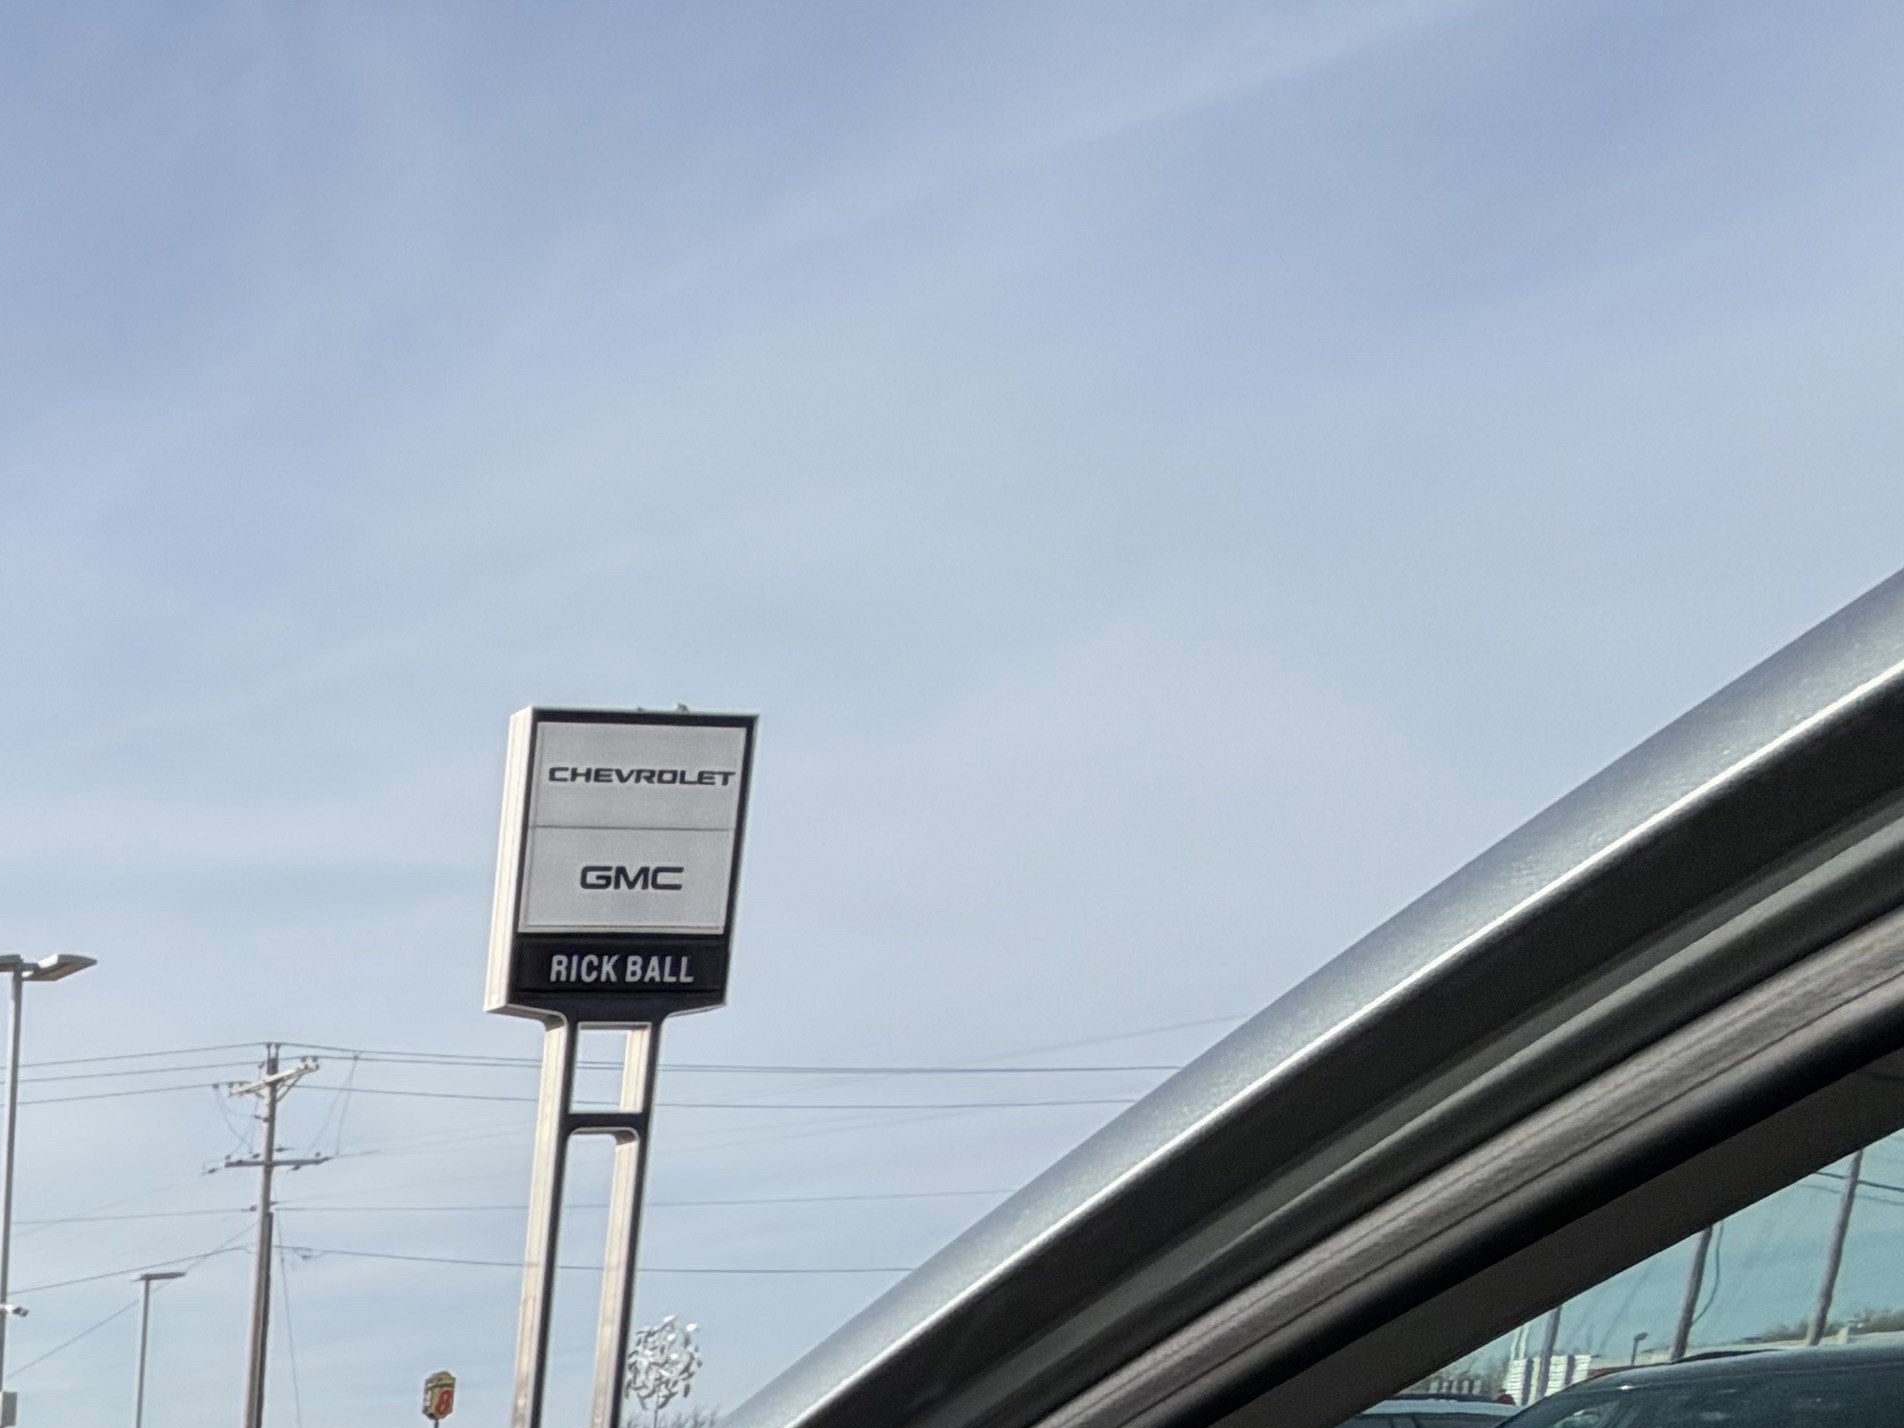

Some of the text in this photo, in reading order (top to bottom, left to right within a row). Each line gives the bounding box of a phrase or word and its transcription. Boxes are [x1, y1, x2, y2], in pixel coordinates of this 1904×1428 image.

[548, 767, 735, 786] CHEVROLET
[580, 866, 684, 890] GMC
[550, 954, 694, 983] RICK BALL
